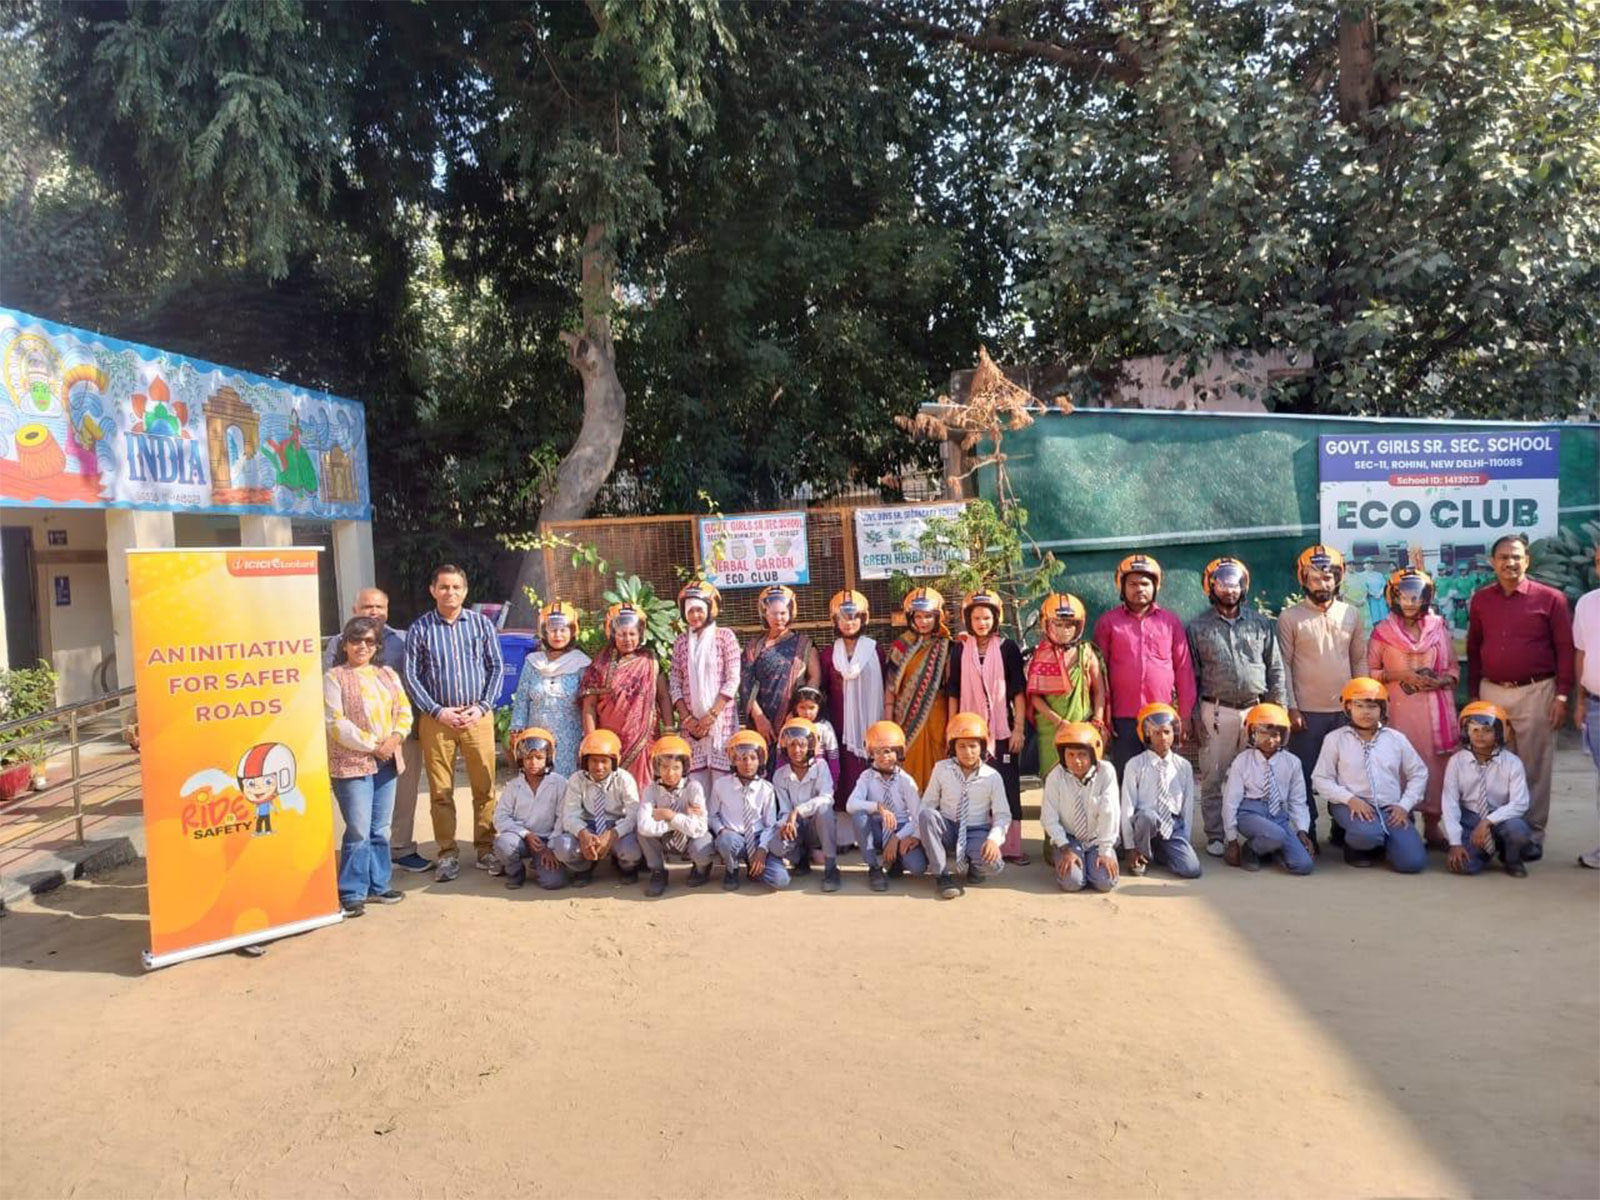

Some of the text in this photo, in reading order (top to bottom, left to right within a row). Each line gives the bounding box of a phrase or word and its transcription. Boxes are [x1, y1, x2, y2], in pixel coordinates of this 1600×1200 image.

[1325, 436, 1553, 455] GOVT. GIRLS SR. SEC. SCHOOL
[124, 431, 207, 486] INDIA
[1354, 458, 1523, 470] SEC-11, ROHINI, NEW DELHI-110085
[1396, 476, 1429, 485] School
[1430, 475, 1443, 484] ID:
[1337, 499, 1539, 529] ECO CLUB
[755, 557, 794, 571] GARDEN
[863, 554, 892, 566] GREEN
[725, 571, 779, 584] ECO CLUB
[148, 638, 315, 665] AN INITIATIVE
[169, 668, 301, 695] FOR SAFER
[196, 698, 282, 722] ROADS
[193, 821, 252, 840] SAFETY
